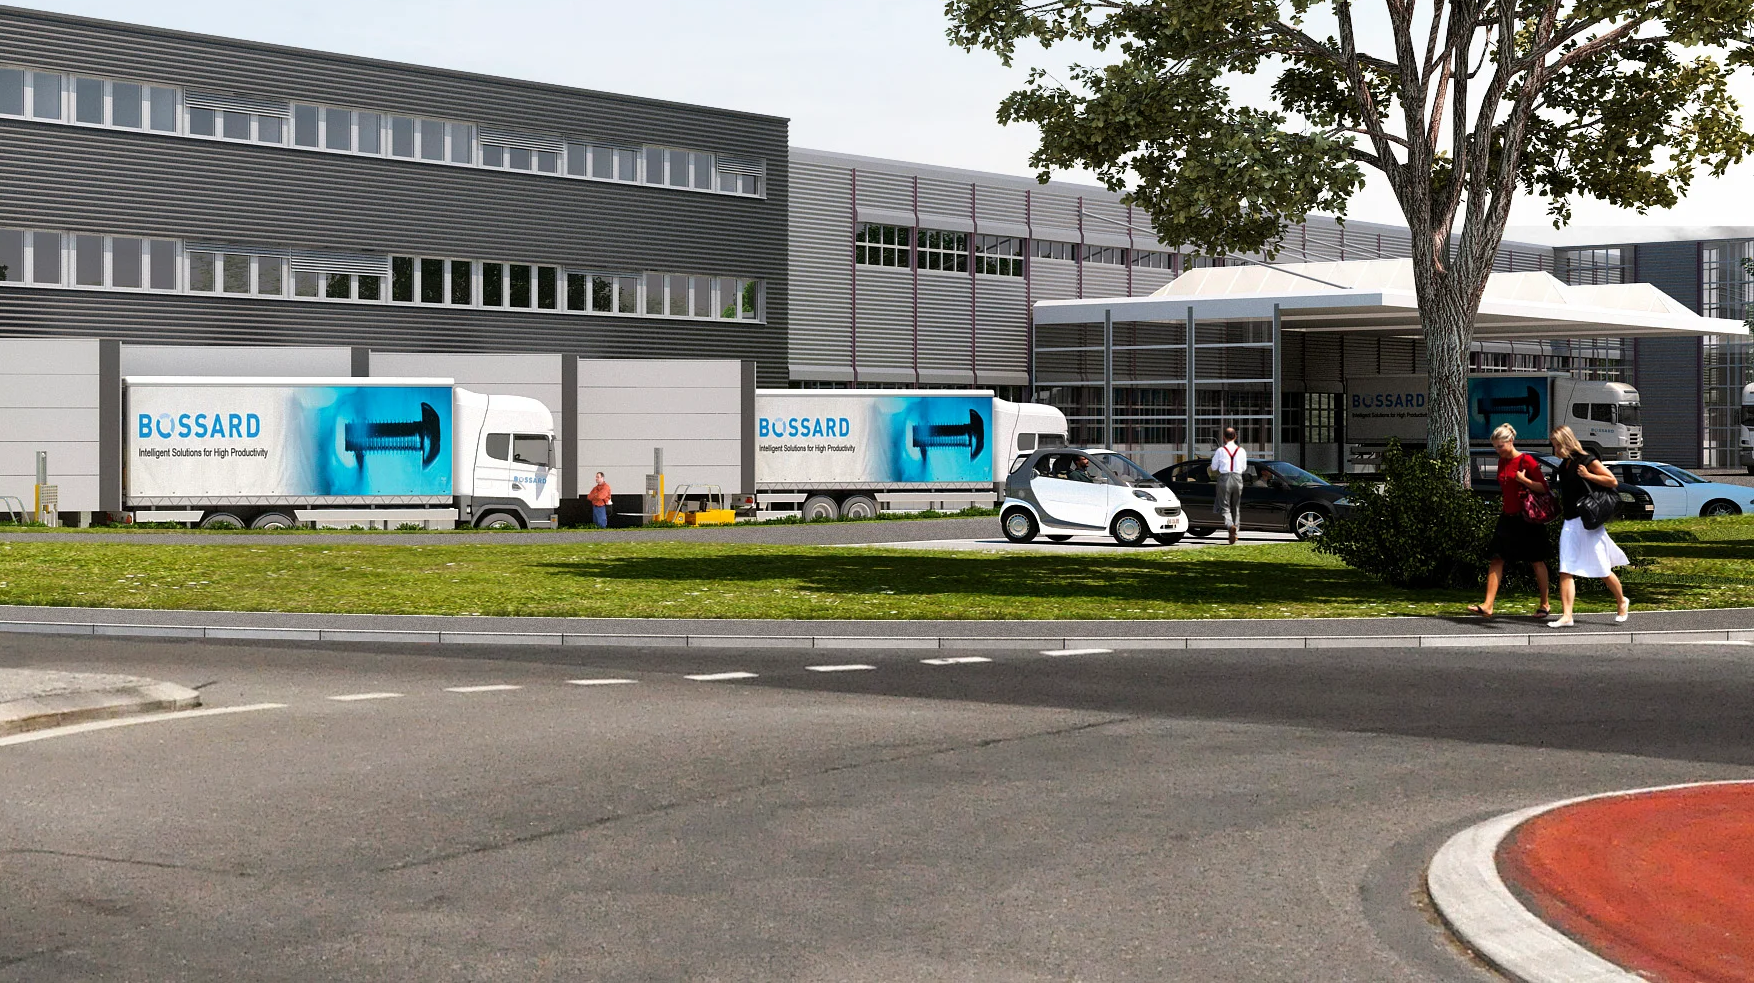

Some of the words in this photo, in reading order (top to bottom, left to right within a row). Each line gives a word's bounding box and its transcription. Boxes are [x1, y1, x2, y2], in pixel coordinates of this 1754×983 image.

[1352, 393, 1425, 408] BOSSARD
[138, 412, 260, 439] BOSSARD
[759, 417, 850, 438] BOSSARD
[138, 447, 171, 459] Intelligent
[171, 447, 202, 457] Solutions
[203, 447, 212, 457] for
[213, 447, 229, 459] High
[230, 447, 268, 459] Productivity
[759, 444, 783, 454] Intelligent
[783, 444, 806, 452] Solutions
[814, 444, 826, 454] High
[827, 444, 856, 454] Productivity
[513, 476, 547, 485] BOSSARD
